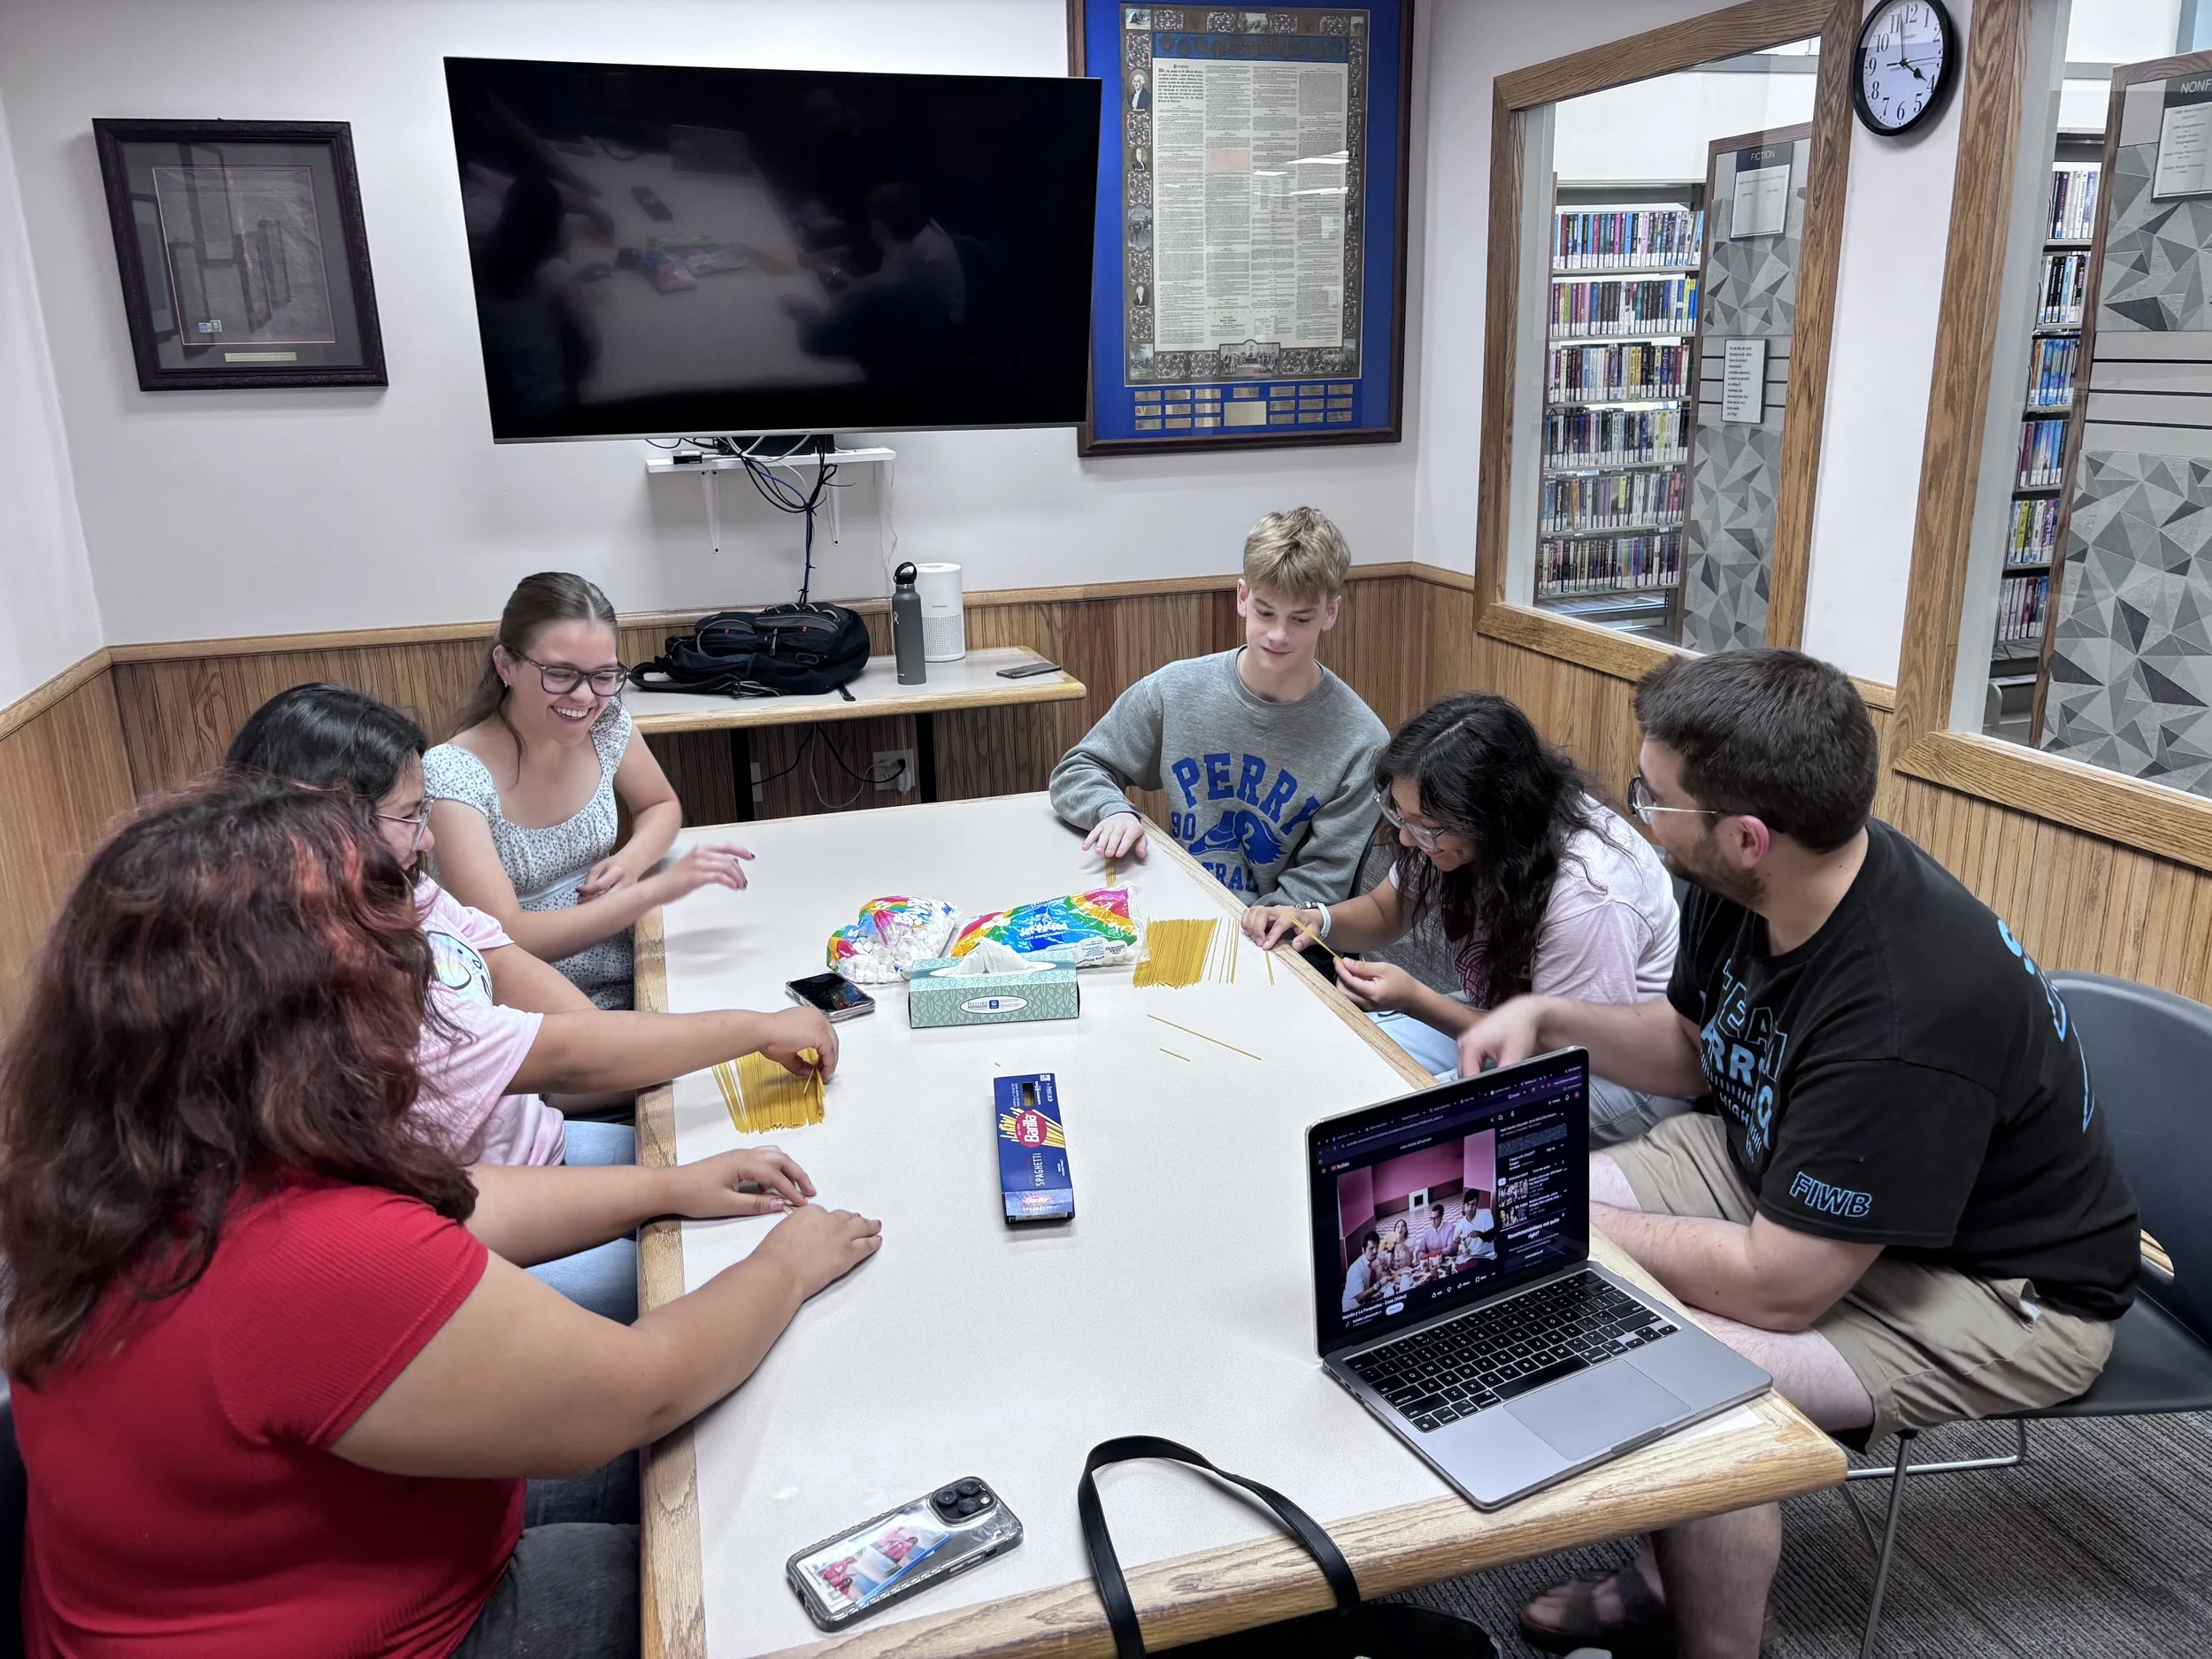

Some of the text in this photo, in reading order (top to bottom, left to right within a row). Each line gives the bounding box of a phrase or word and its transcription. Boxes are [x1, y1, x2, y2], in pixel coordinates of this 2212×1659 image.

[1890, 13, 1901, 34] 11
[1905, 4, 1918, 24] 12
[1924, 8, 1930, 27] 1
[1876, 33, 1889, 53] 10
[1869, 58, 1876, 76] 9
[1871, 81, 1879, 100] 8
[1926, 74, 1935, 94] 4
[1882, 96, 1890, 116] 7
[1896, 100, 1906, 120] 6
[1913, 92, 1923, 112] 5
[1750, 150, 1776, 161] FICTION
[1171, 811, 1196, 841] 90
[1024, 1114, 1040, 1143] Barilla
[1033, 1153, 1045, 1187] SPAGHETTI
[1789, 1171, 1872, 1217] FIWB
